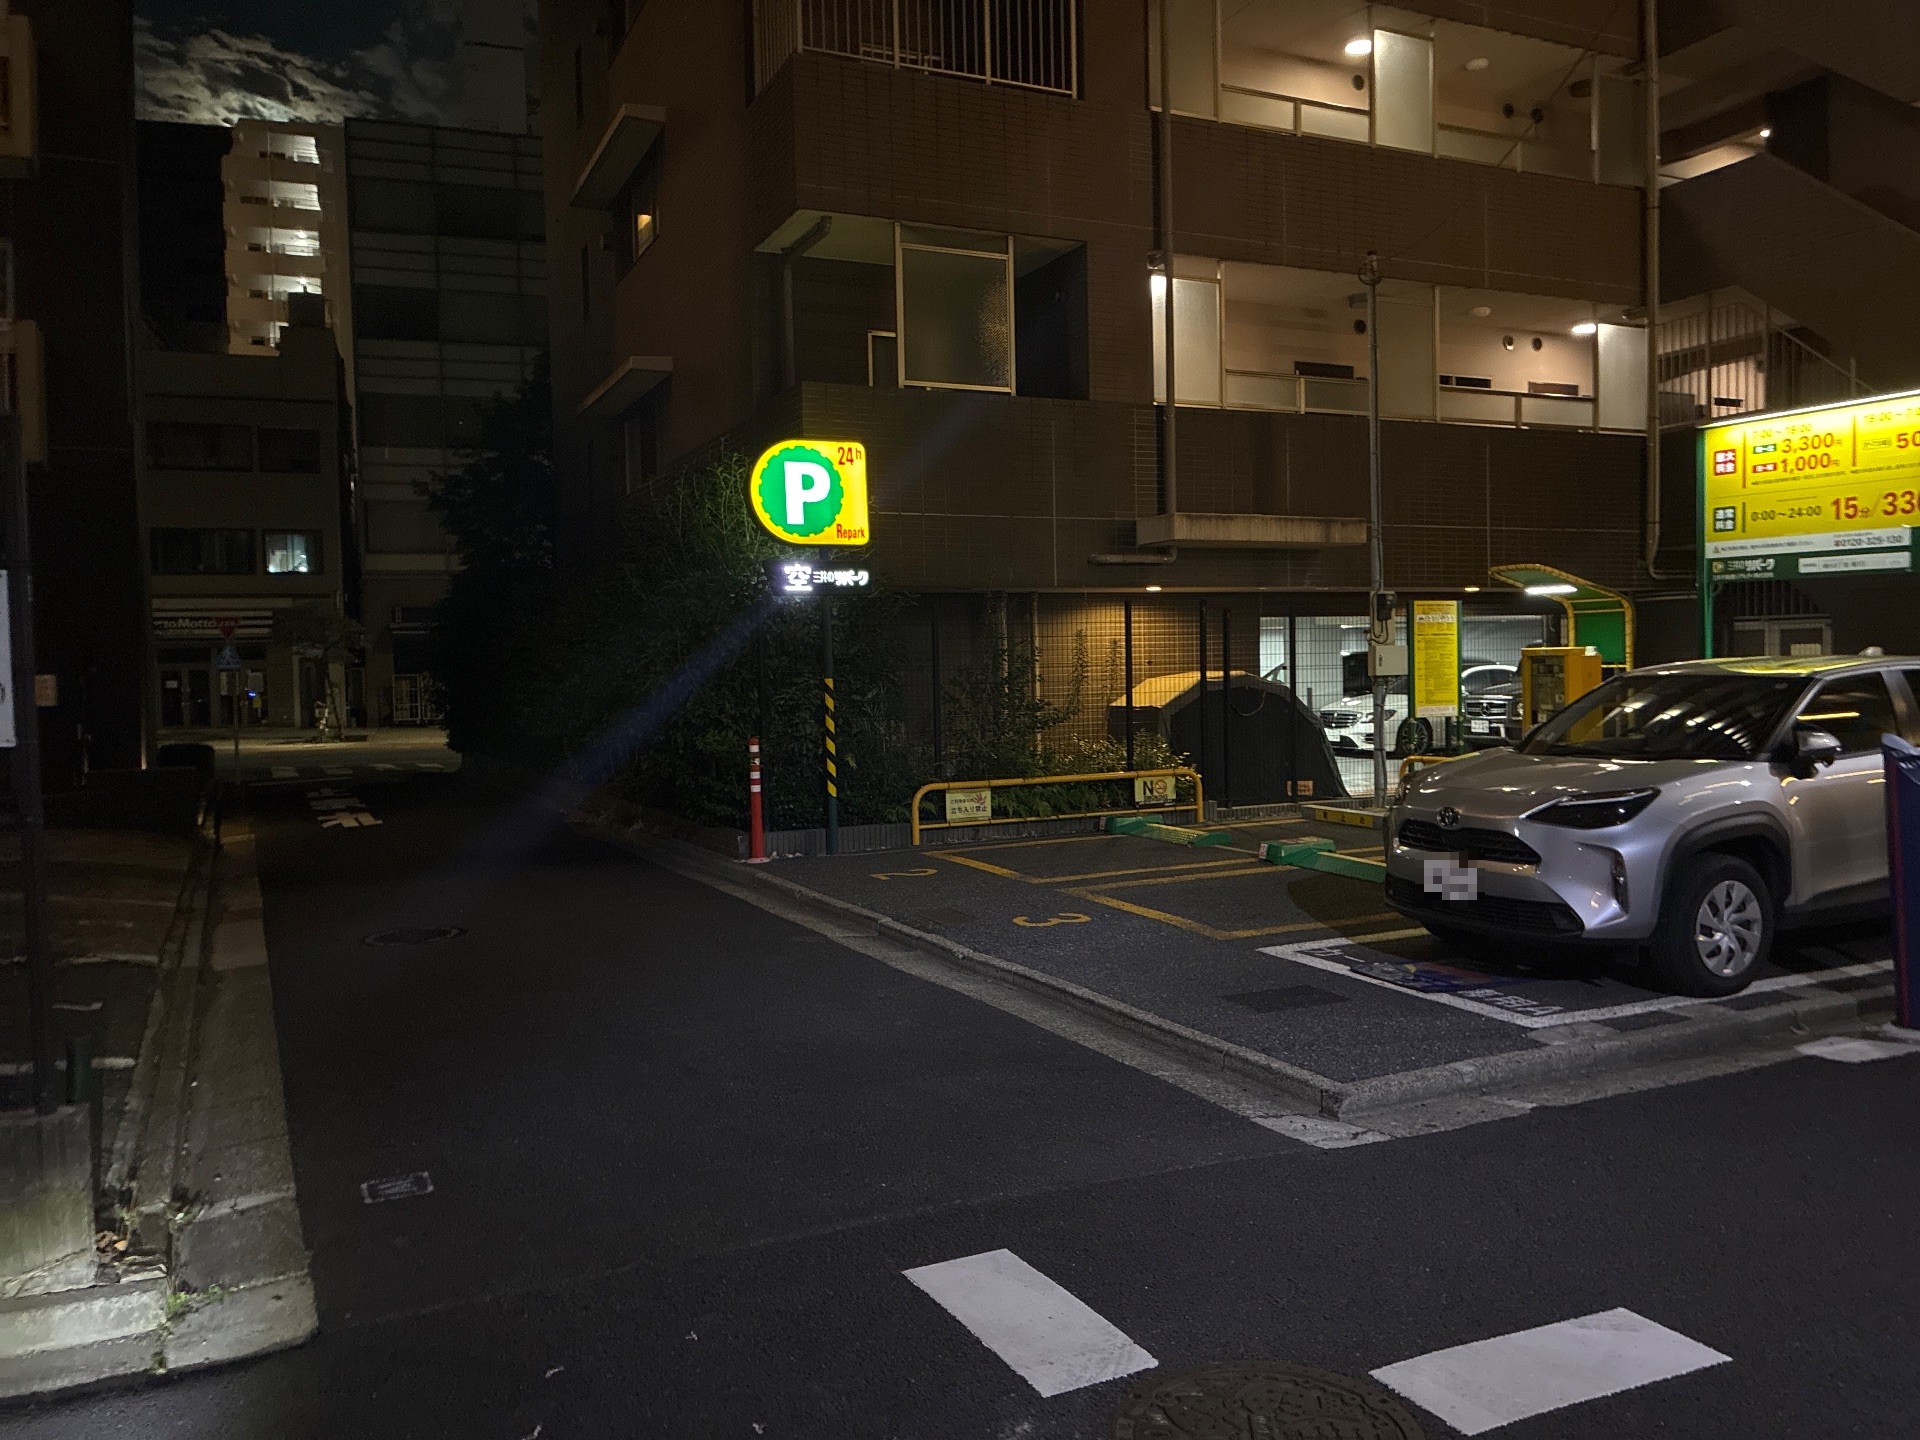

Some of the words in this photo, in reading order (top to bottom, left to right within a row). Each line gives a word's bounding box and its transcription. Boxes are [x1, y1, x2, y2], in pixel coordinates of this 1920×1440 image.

[784, 461, 831, 525] P
[836, 524, 866, 541] Repark
[783, 563, 813, 592] 空
[950, 805, 987, 815] 立ち入り禁止
[1012, 912, 1093, 928] 3
